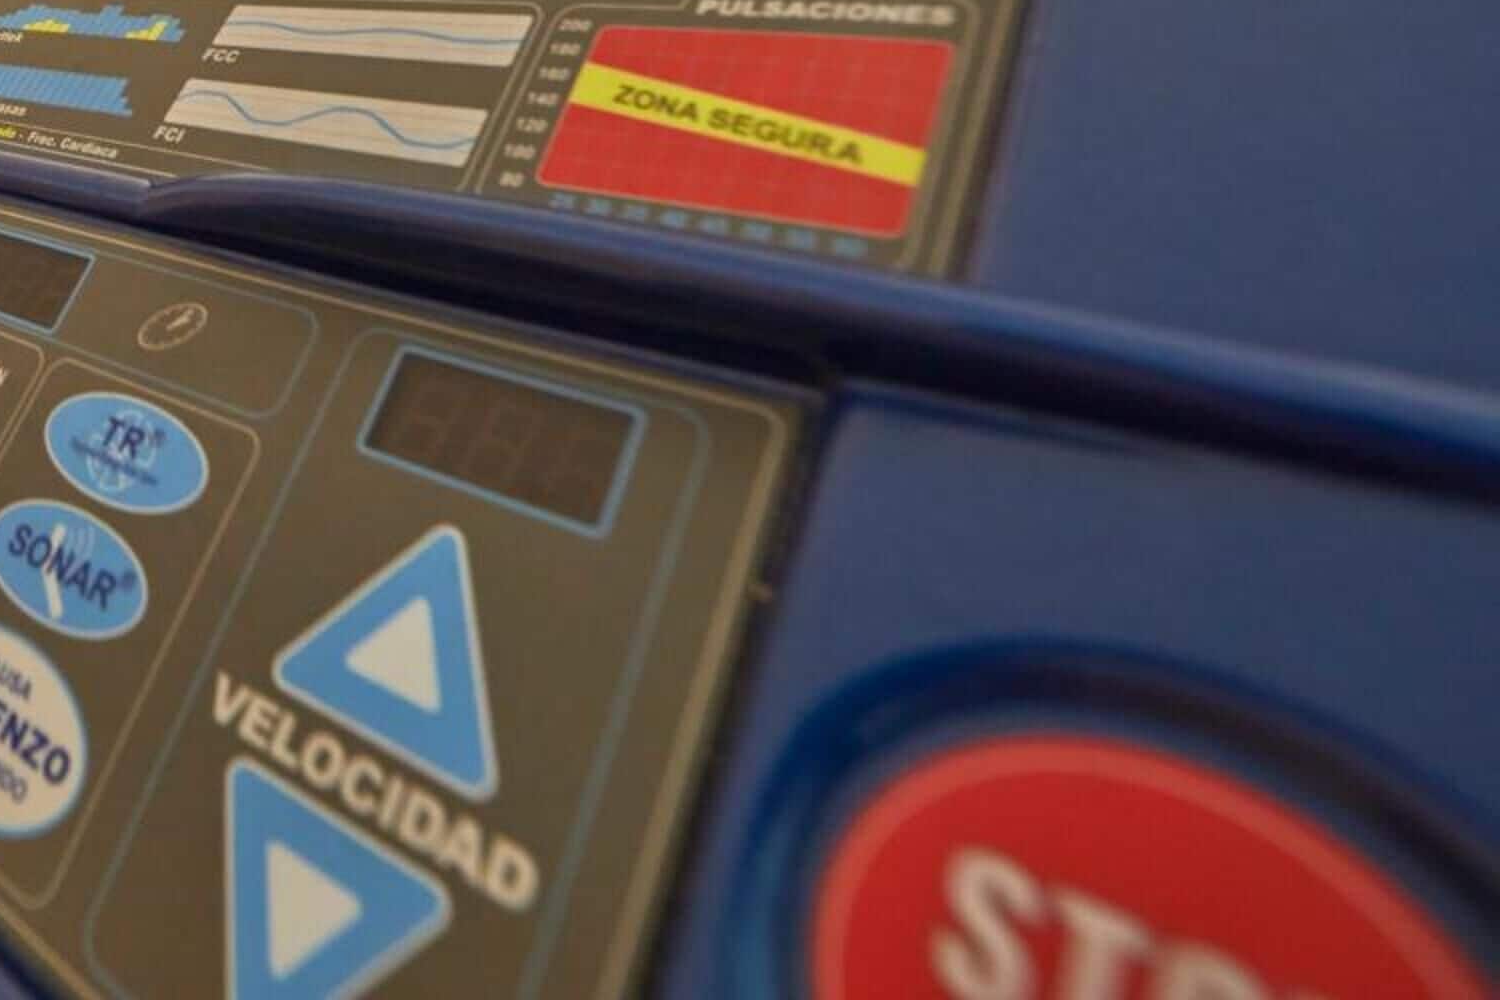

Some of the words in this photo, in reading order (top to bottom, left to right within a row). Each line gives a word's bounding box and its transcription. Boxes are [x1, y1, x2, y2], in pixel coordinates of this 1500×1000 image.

[203, 49, 240, 64] FCC
[154, 126, 184, 144] FCI
[611, 82, 700, 124] ZONA
[706, 107, 864, 166] SEGURA
[212, 668, 539, 913] VELOCIDAD
[925, 845, 1342, 1000] ST
